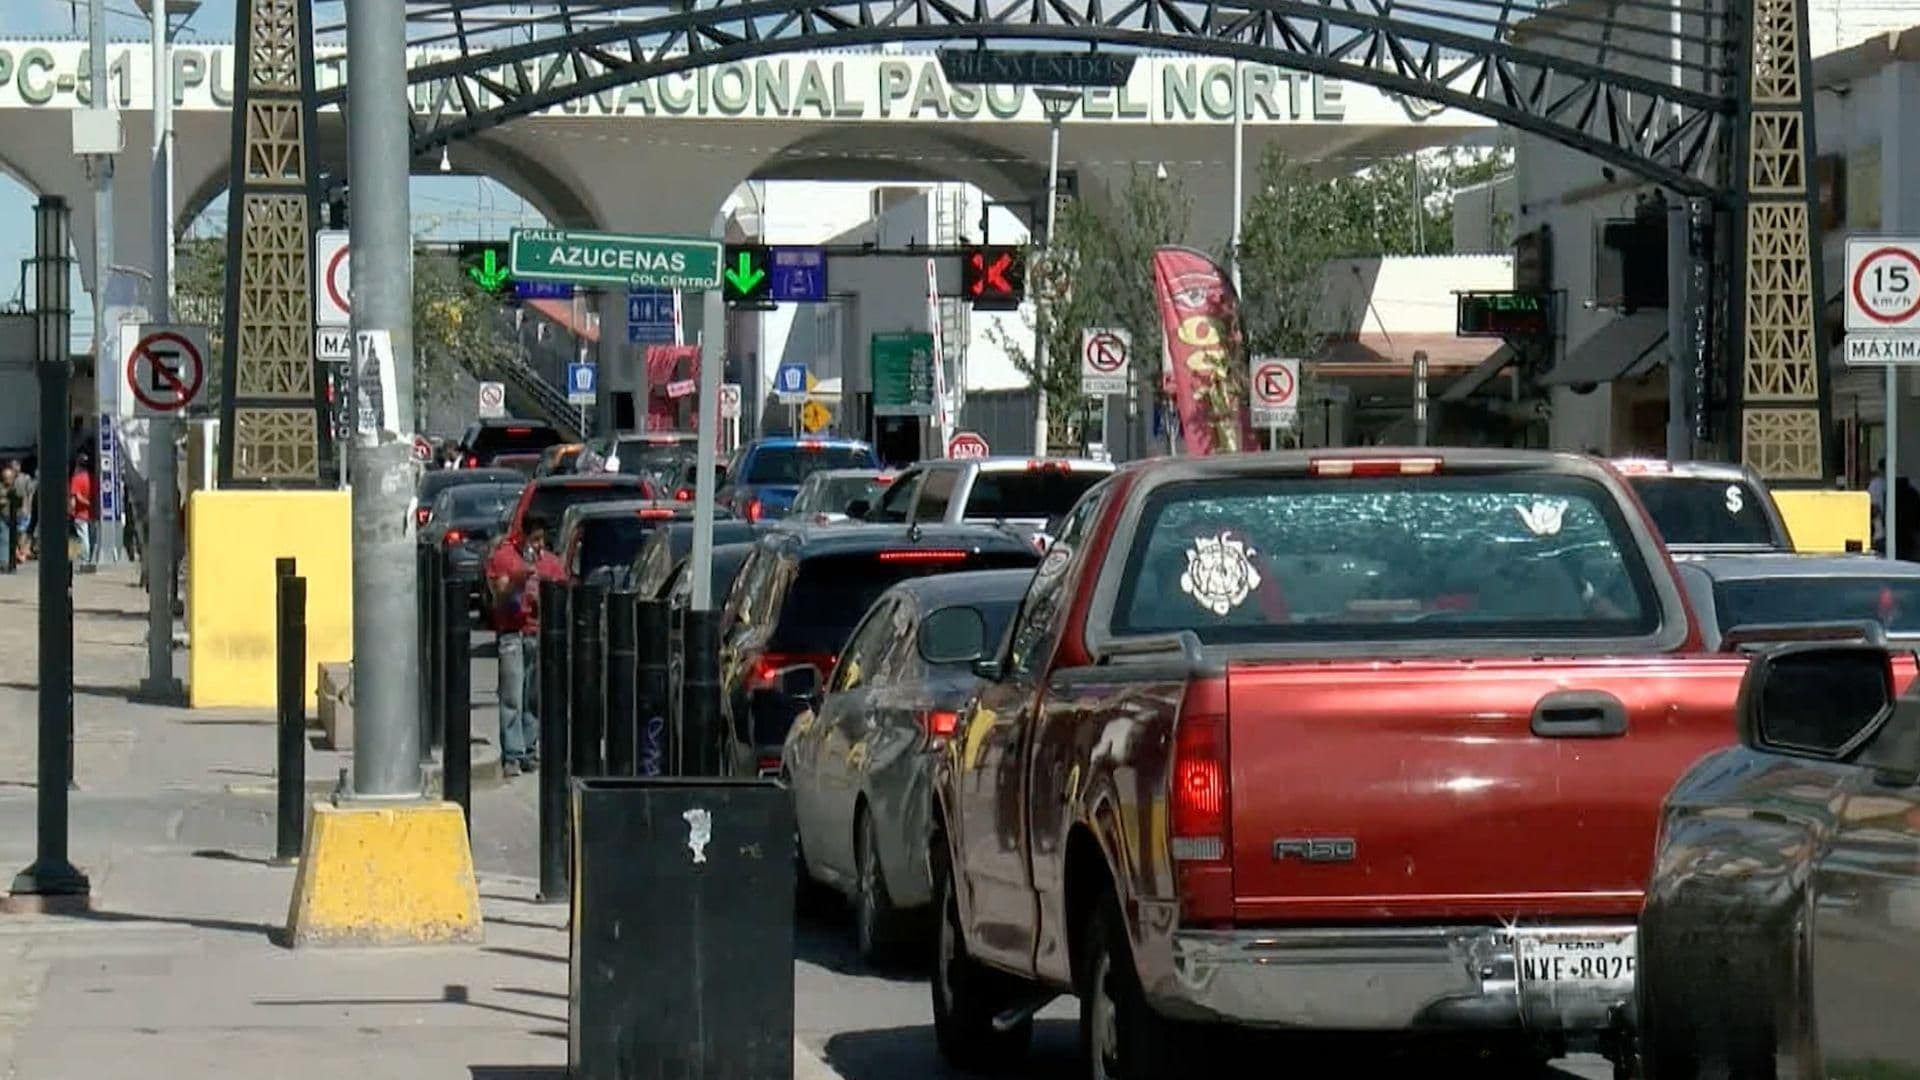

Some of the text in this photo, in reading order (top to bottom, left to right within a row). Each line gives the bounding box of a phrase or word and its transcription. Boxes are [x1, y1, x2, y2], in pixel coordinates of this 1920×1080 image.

[879, 61, 1025, 118] PASO
[1163, 63, 1346, 120] NORTE
[522, 230, 565, 241] CALLE
[549, 246, 686, 272] AZUCENAS
[660, 275, 713, 288] CENTRO
[1874, 266, 1910, 292] 15
[1872, 296, 1911, 307] km/h
[953, 443, 984, 459] ALTO
